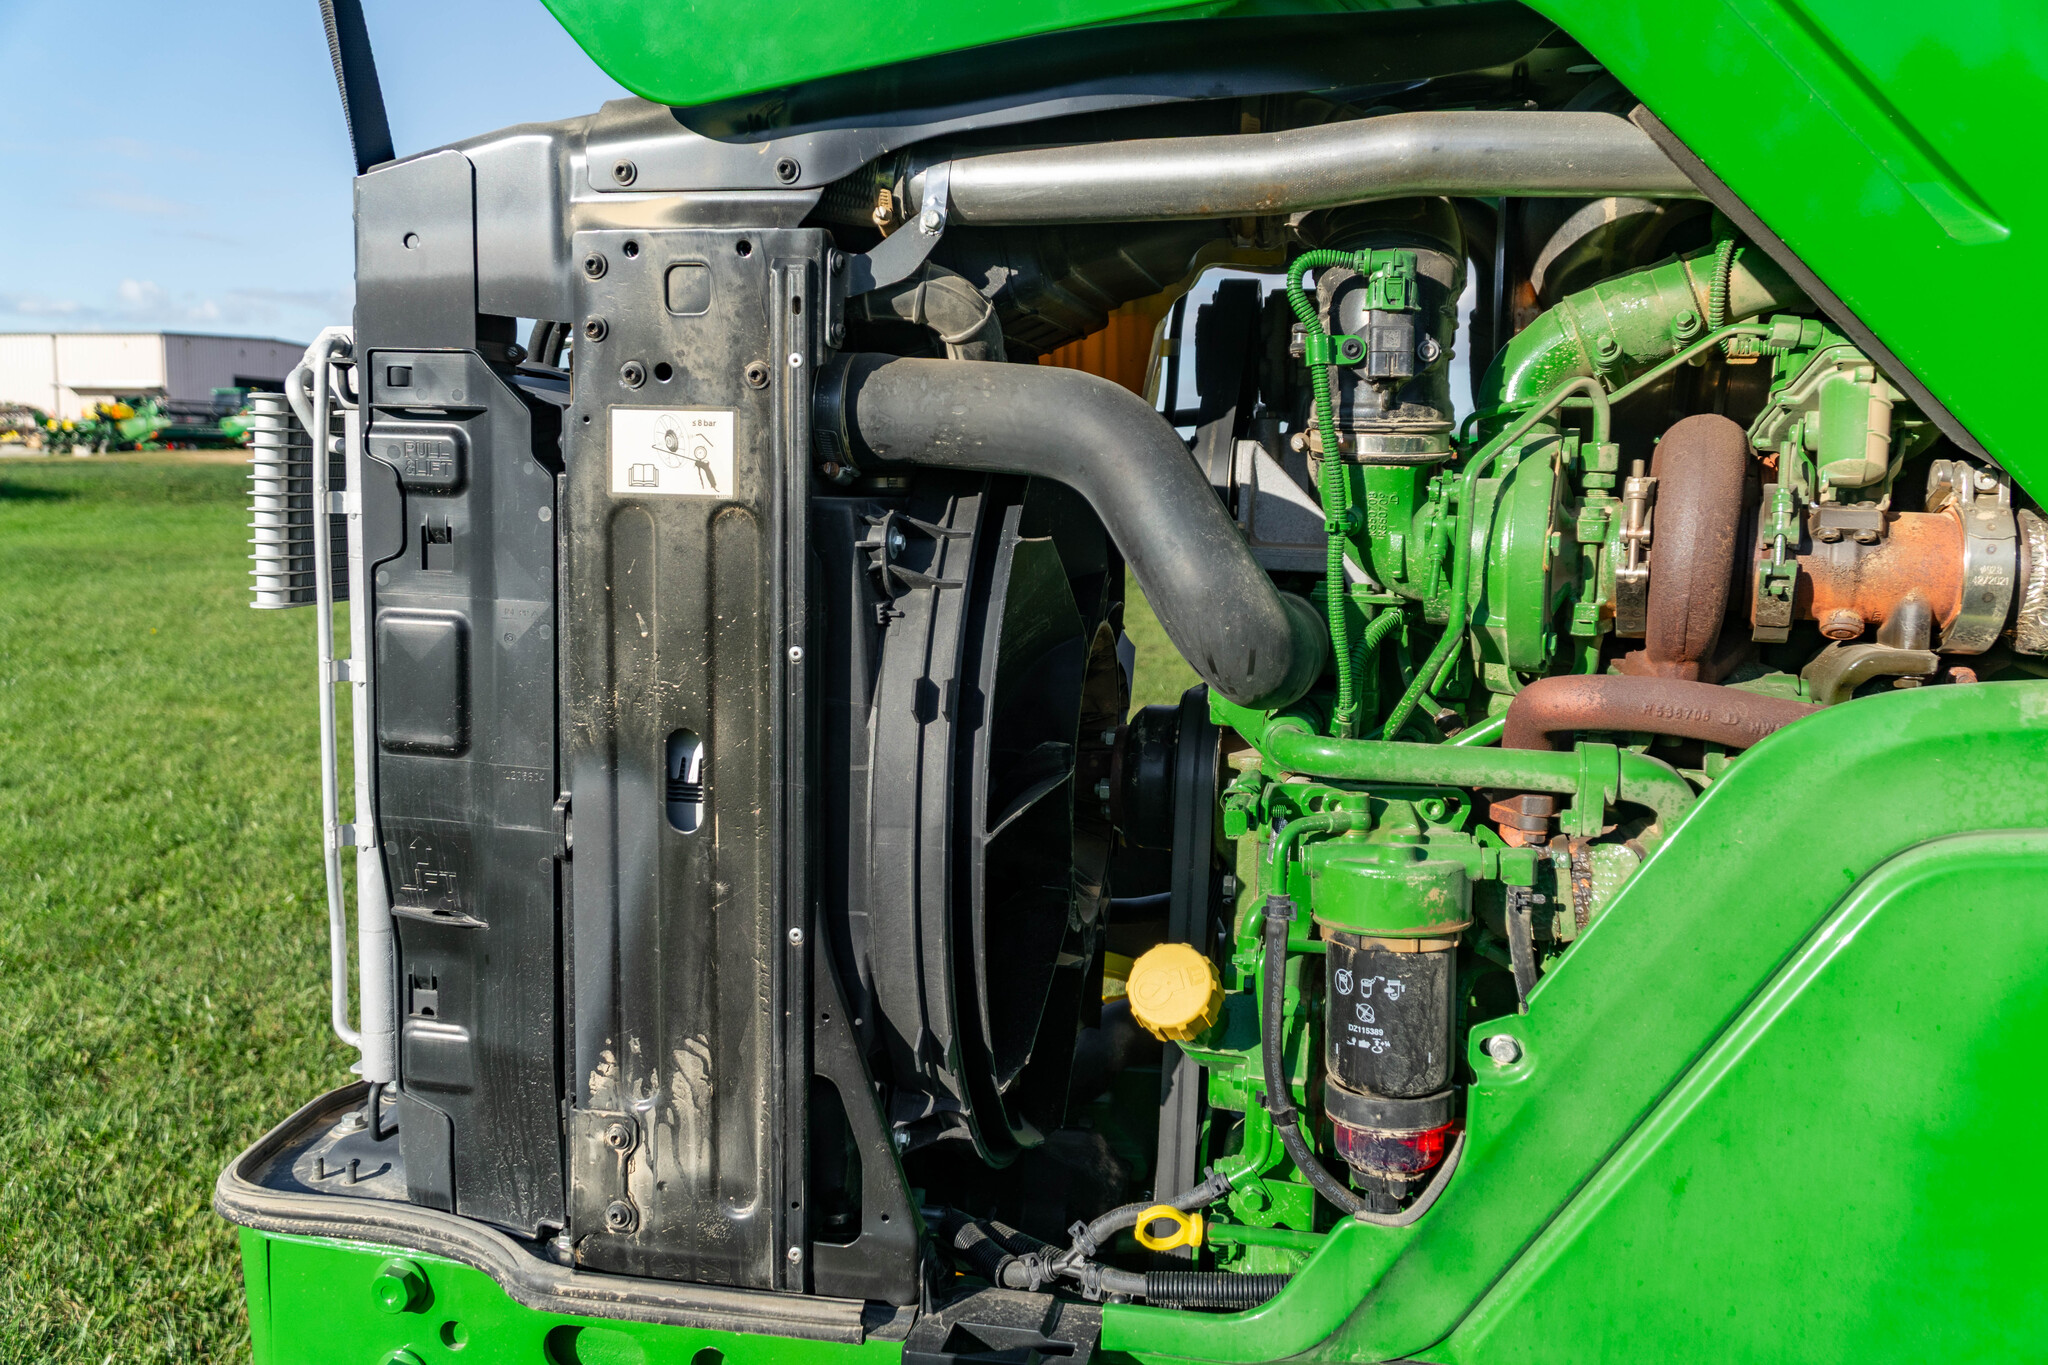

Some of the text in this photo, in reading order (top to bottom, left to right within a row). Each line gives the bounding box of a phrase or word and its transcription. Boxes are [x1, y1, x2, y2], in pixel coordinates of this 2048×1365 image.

[703, 419, 716, 427] bar
[404, 440, 450, 459] PULL
[404, 458, 453, 477] &LIFT
[1348, 1023, 1384, 1036] DZ115389
